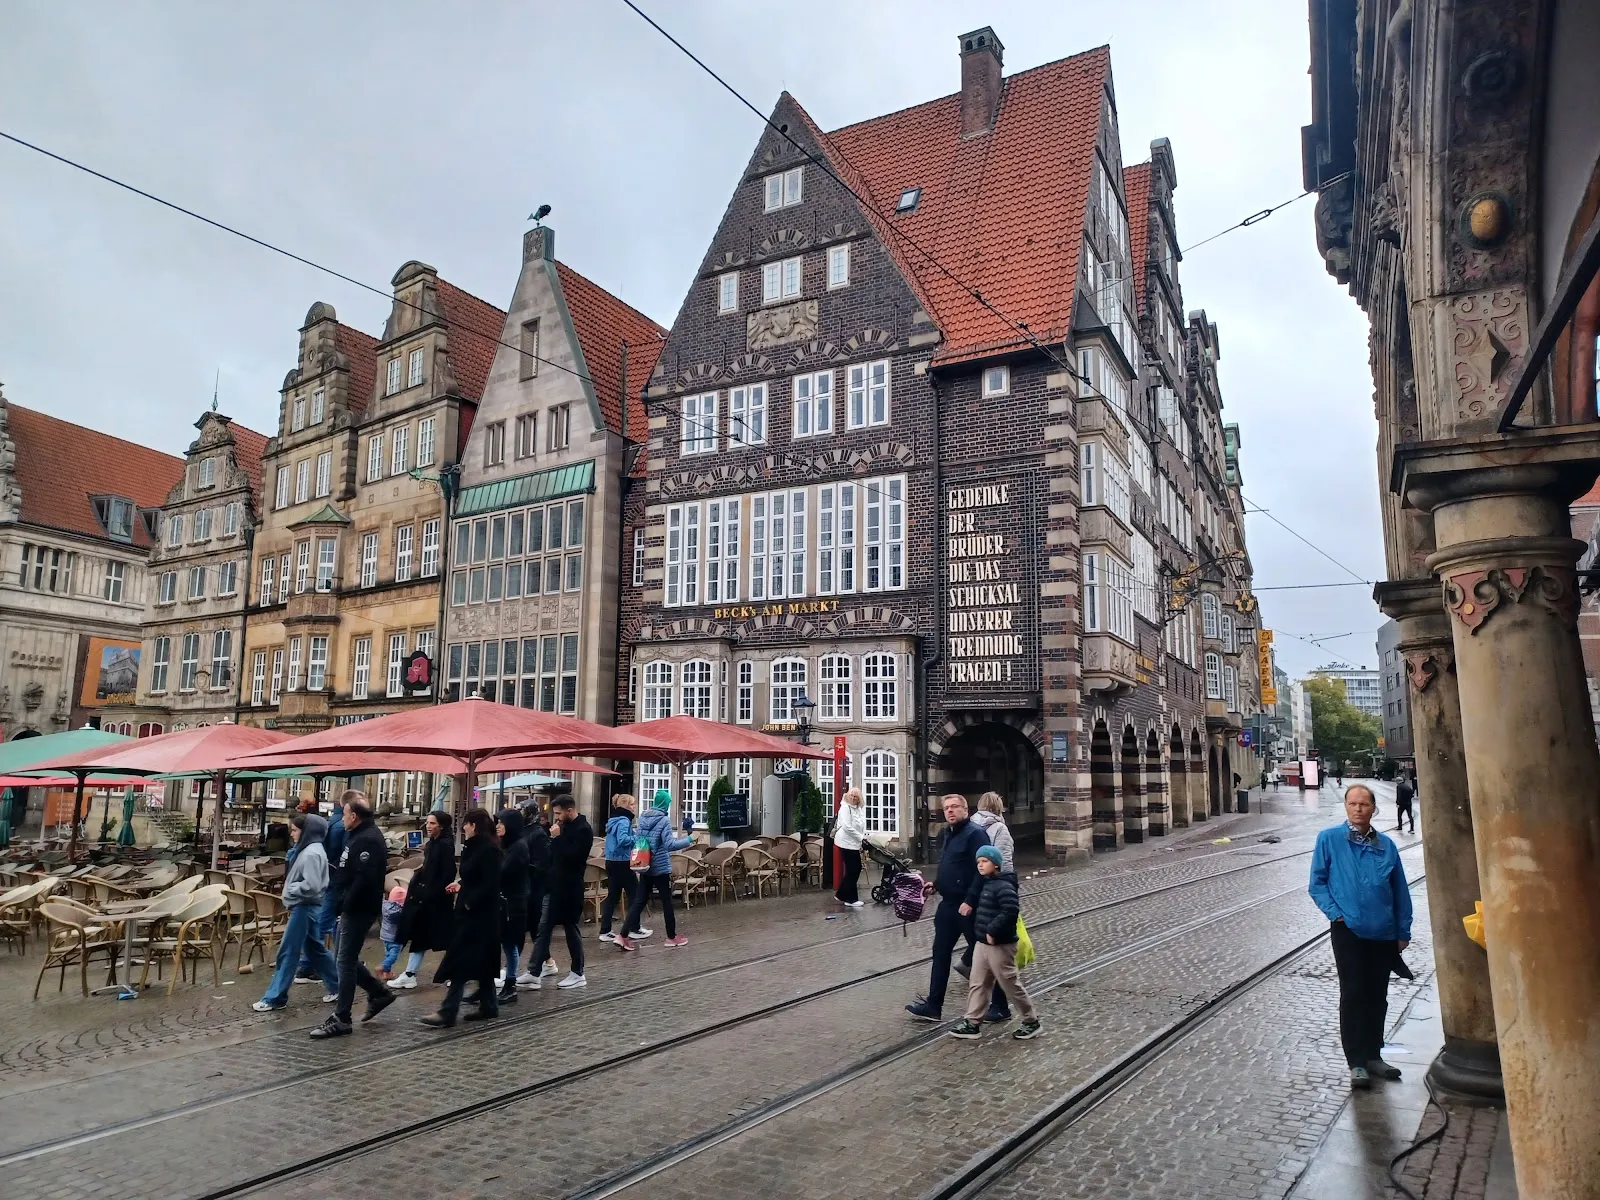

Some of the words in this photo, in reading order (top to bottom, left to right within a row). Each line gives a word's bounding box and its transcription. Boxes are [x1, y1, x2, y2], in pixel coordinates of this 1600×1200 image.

[949, 484, 1009, 509] GEDENKE
[949, 513, 975, 534] DER
[949, 534, 1010, 558] BRÜDER,
[950, 562, 970, 583] DIE
[975, 559, 1001, 581] DAS
[949, 583, 1021, 608] SCHICKSAL
[762, 604, 782, 616] AM
[788, 600, 840, 614] MARKT
[950, 610, 1012, 632] UNSERER
[949, 635, 1023, 657] TRENNUNG
